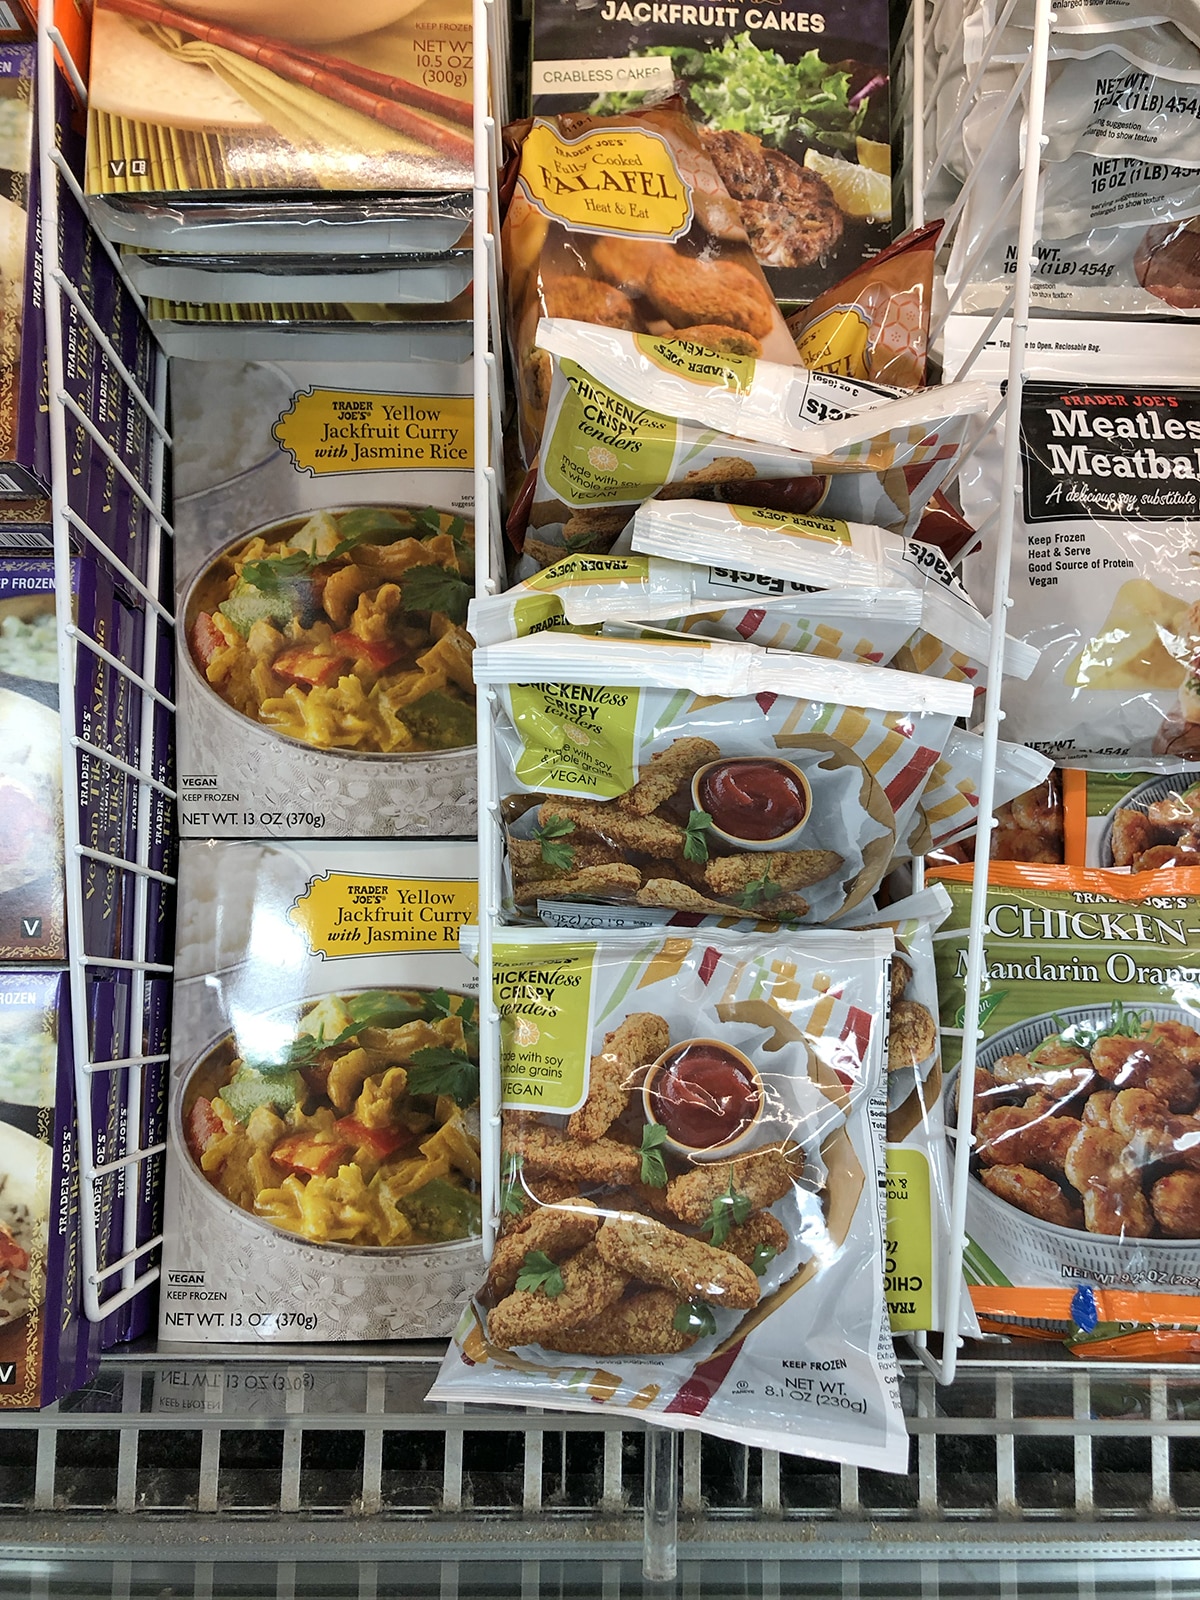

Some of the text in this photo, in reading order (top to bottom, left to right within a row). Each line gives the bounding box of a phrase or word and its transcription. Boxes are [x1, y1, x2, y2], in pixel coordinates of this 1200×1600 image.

[600, 1, 825, 34] JACKFRUIT CAKES
[416, 22, 473, 32] KEEP FROZEN
[414, 40, 446, 53] NET
[417, 54, 473, 69] 10.5 OZ
[423, 70, 467, 87] (300g)
[543, 69, 614, 84] CRABLESS
[1106, 121, 1142, 131] suggestion
[1108, 130, 1158, 144] to show texture
[555, 139, 624, 158] TRADER JOE'S
[110, 161, 124, 177] V
[554, 154, 643, 175] Fully Cooked
[1092, 158, 1121, 177] NET
[538, 165, 678, 201] FALAFEL
[1092, 176, 1107, 194] 16
[1144, 165, 1169, 181] LB)
[584, 198, 650, 219] Heat & Eat
[1038, 248, 1061, 262] WT.
[1055, 262, 1077, 275] LB)
[1079, 263, 1116, 277] 454g
[33, 250, 43, 308] TRADER
[67, 326, 77, 379] TRADER
[1000, 340, 1011, 348] Tea
[1037, 342, 1053, 350] Open.
[1055, 342, 1087, 351] Reclosable
[1088, 344, 1101, 352] Bag.
[99, 373, 108, 422] TRADER
[852, 389, 859, 397] 3
[332, 401, 374, 411] TRADER
[566, 376, 666, 430] CHICKENless
[1060, 396, 1180, 408] TRADER JOE'S
[338, 411, 367, 421] JOE'S
[381, 405, 441, 422] Yellow
[583, 405, 639, 436] CRISPY
[126, 409, 135, 454] TRADER
[321, 423, 459, 445] Jackfruit Curry
[578, 420, 643, 454] tenders
[314, 443, 468, 462] with Jasmine Rice
[562, 454, 618, 486] made with
[568, 470, 600, 491] whole
[570, 488, 618, 499] VEGAN
[1046, 483, 1063, 505] A
[1066, 481, 1116, 504] delicious
[1140, 488, 1196, 506] substitute
[757, 510, 836, 532] TRADER JOE'S
[1028, 533, 1086, 547] Keep Frozen
[1028, 547, 1091, 559] Heat & Serve
[580, 560, 629, 572] TRADER
[1028, 558, 1134, 573] Good Source of Protein
[1029, 576, 1058, 587] Vegan
[543, 695, 600, 720] CRISPY
[544, 704, 603, 734] tenders
[573, 746, 613, 771] with soy
[81, 754, 90, 807] TRADER
[549, 770, 597, 786] VEGAN
[182, 794, 240, 802] KEEP FROZEN
[182, 813, 326, 828] NET WT. 13 OZ (370g)
[347, 886, 389, 895] TRADER
[397, 890, 455, 905] Yellow
[352, 896, 381, 905] JOE'S
[334, 907, 472, 926] Jackfruit Curry
[24, 920, 40, 936] V
[328, 927, 437, 945] with Jasmine
[519, 1052, 564, 1067] with soy
[529, 1066, 563, 1079] grains
[58, 1132, 71, 1235] TRADER JOE'S
[168, 1274, 205, 1284] VEGAN
[1062, 1265, 1168, 1285] NET WT OZ
[167, 1292, 227, 1301] KEEP FROZEN
[165, 1312, 318, 1330] NET WT. 13 OZ (370g)
[0, 1364, 14, 1382] V
[782, 1358, 848, 1371] KEEP FROZEN
[786, 1378, 847, 1396] NET WT.
[764, 1385, 868, 1415] 8.1 OZ (230g)
